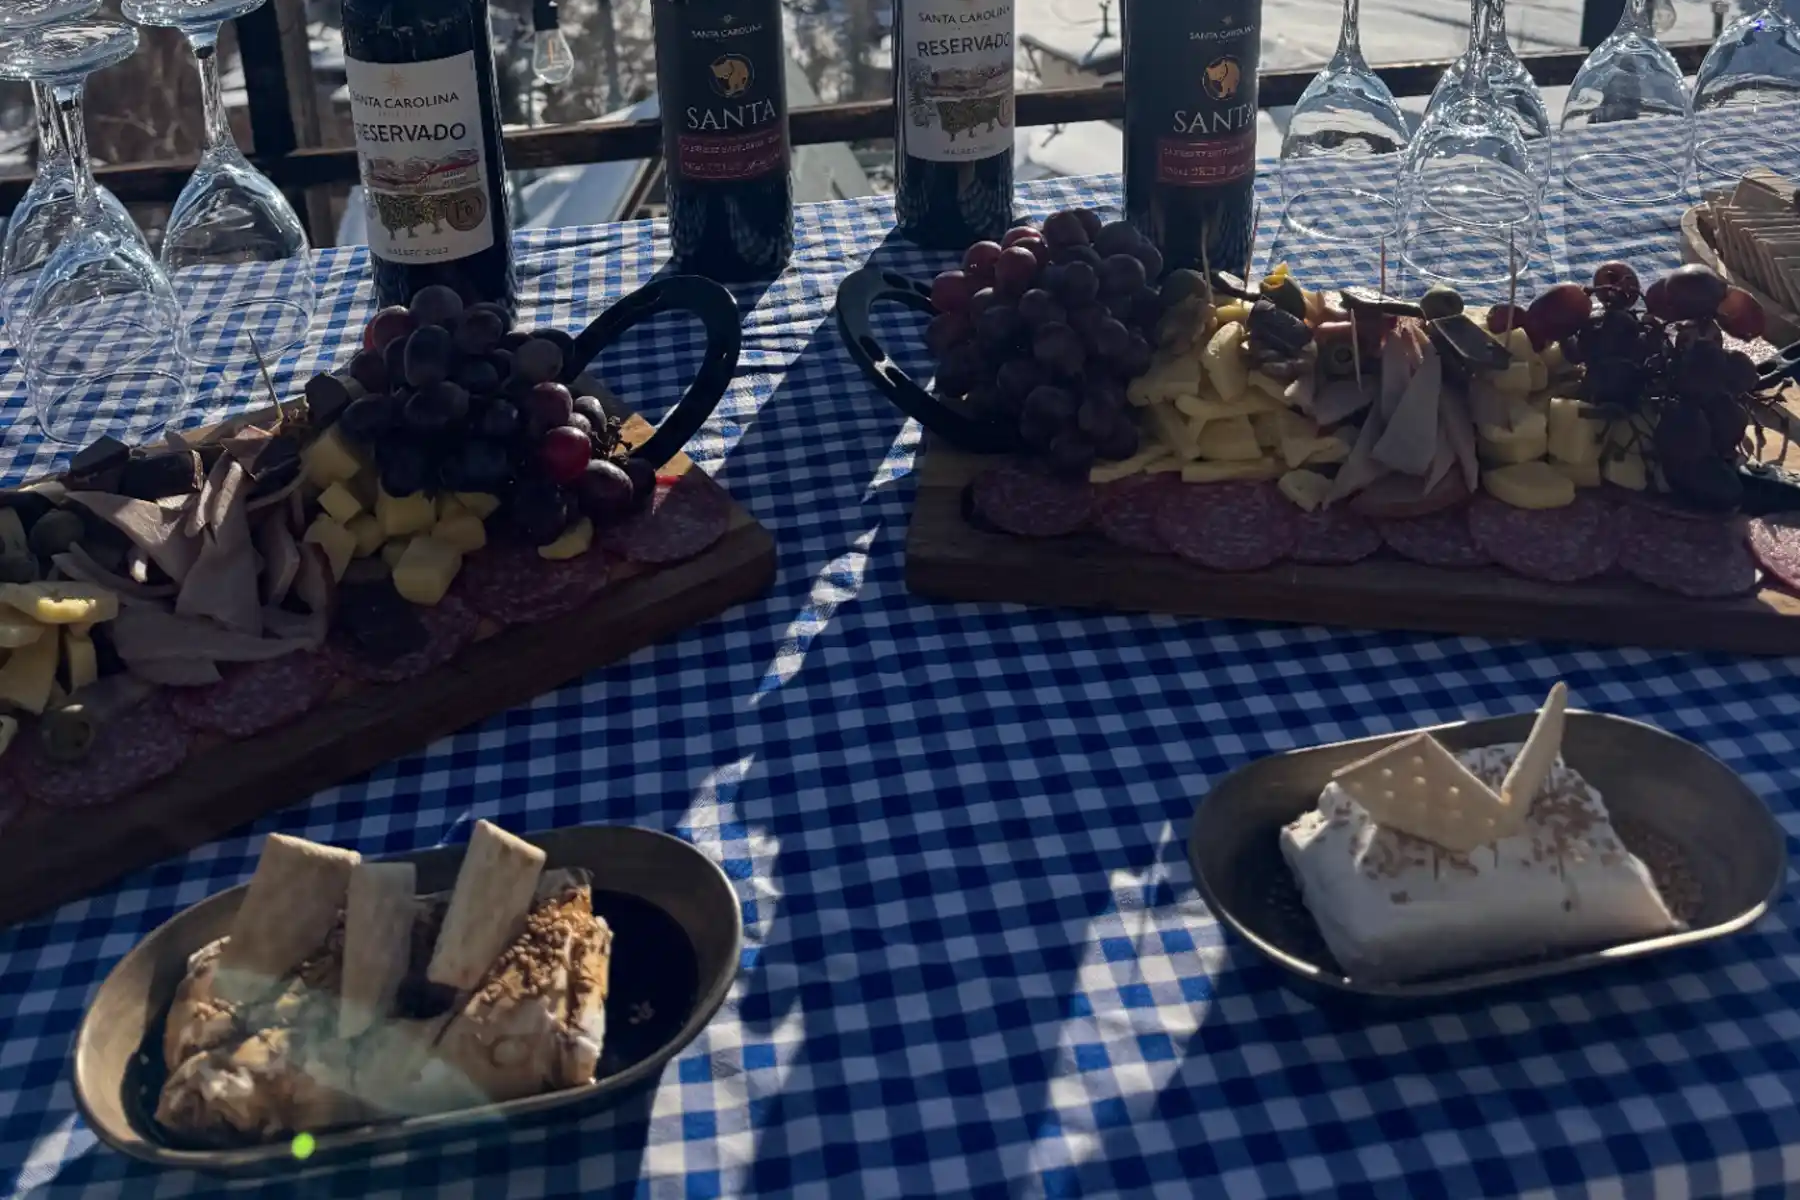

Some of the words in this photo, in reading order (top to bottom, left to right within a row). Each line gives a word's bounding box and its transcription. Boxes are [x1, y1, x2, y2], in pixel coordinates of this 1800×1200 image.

[918, 11, 957, 25] SANTA
[1189, 32, 1218, 40] SANTA
[384, 91, 460, 109] CAROLINA
[686, 98, 776, 130] SANTA
[1173, 102, 1256, 134] SANTA
